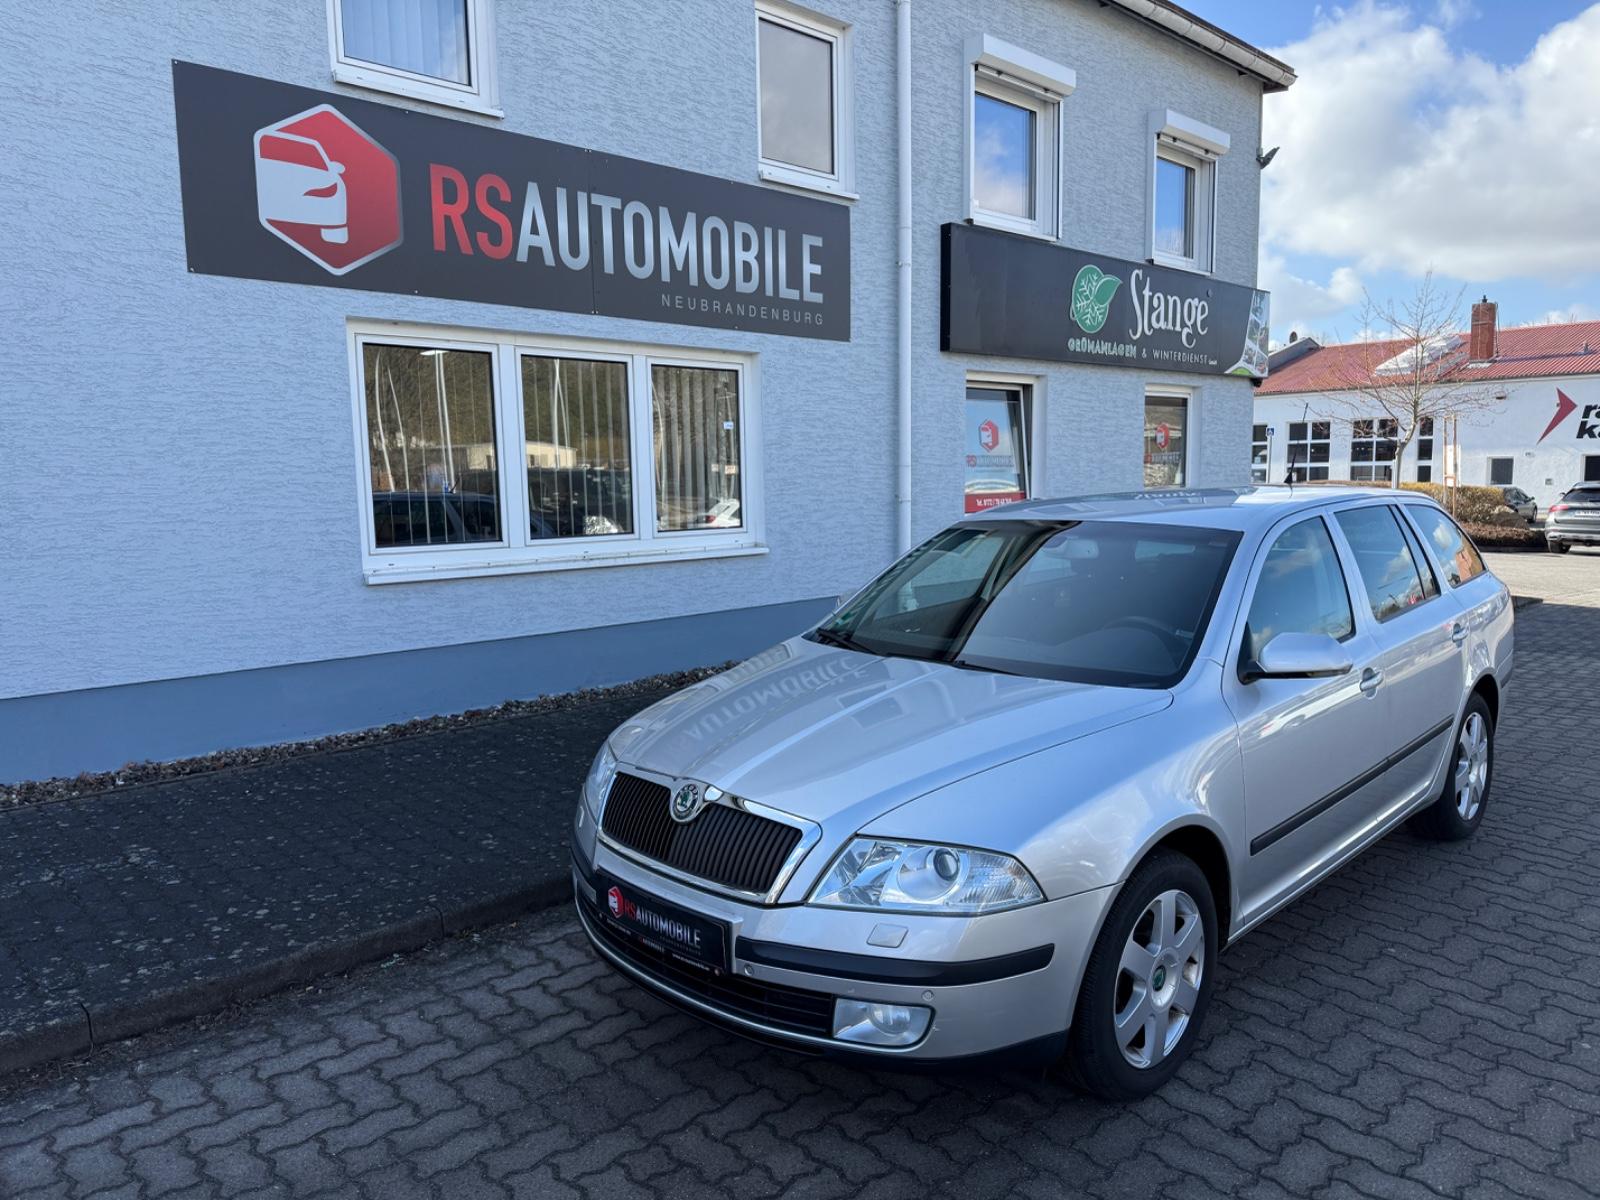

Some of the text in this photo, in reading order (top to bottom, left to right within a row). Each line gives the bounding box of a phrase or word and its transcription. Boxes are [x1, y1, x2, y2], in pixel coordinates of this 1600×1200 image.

[661, 293, 824, 326] NEUBRANDENBURG
[1129, 269, 1209, 348] Stange
[1068, 337, 1137, 359] GRÜNANLAGEN
[1141, 348, 1147, 359] &
[1152, 349, 1208, 365] WINTERDIENST
